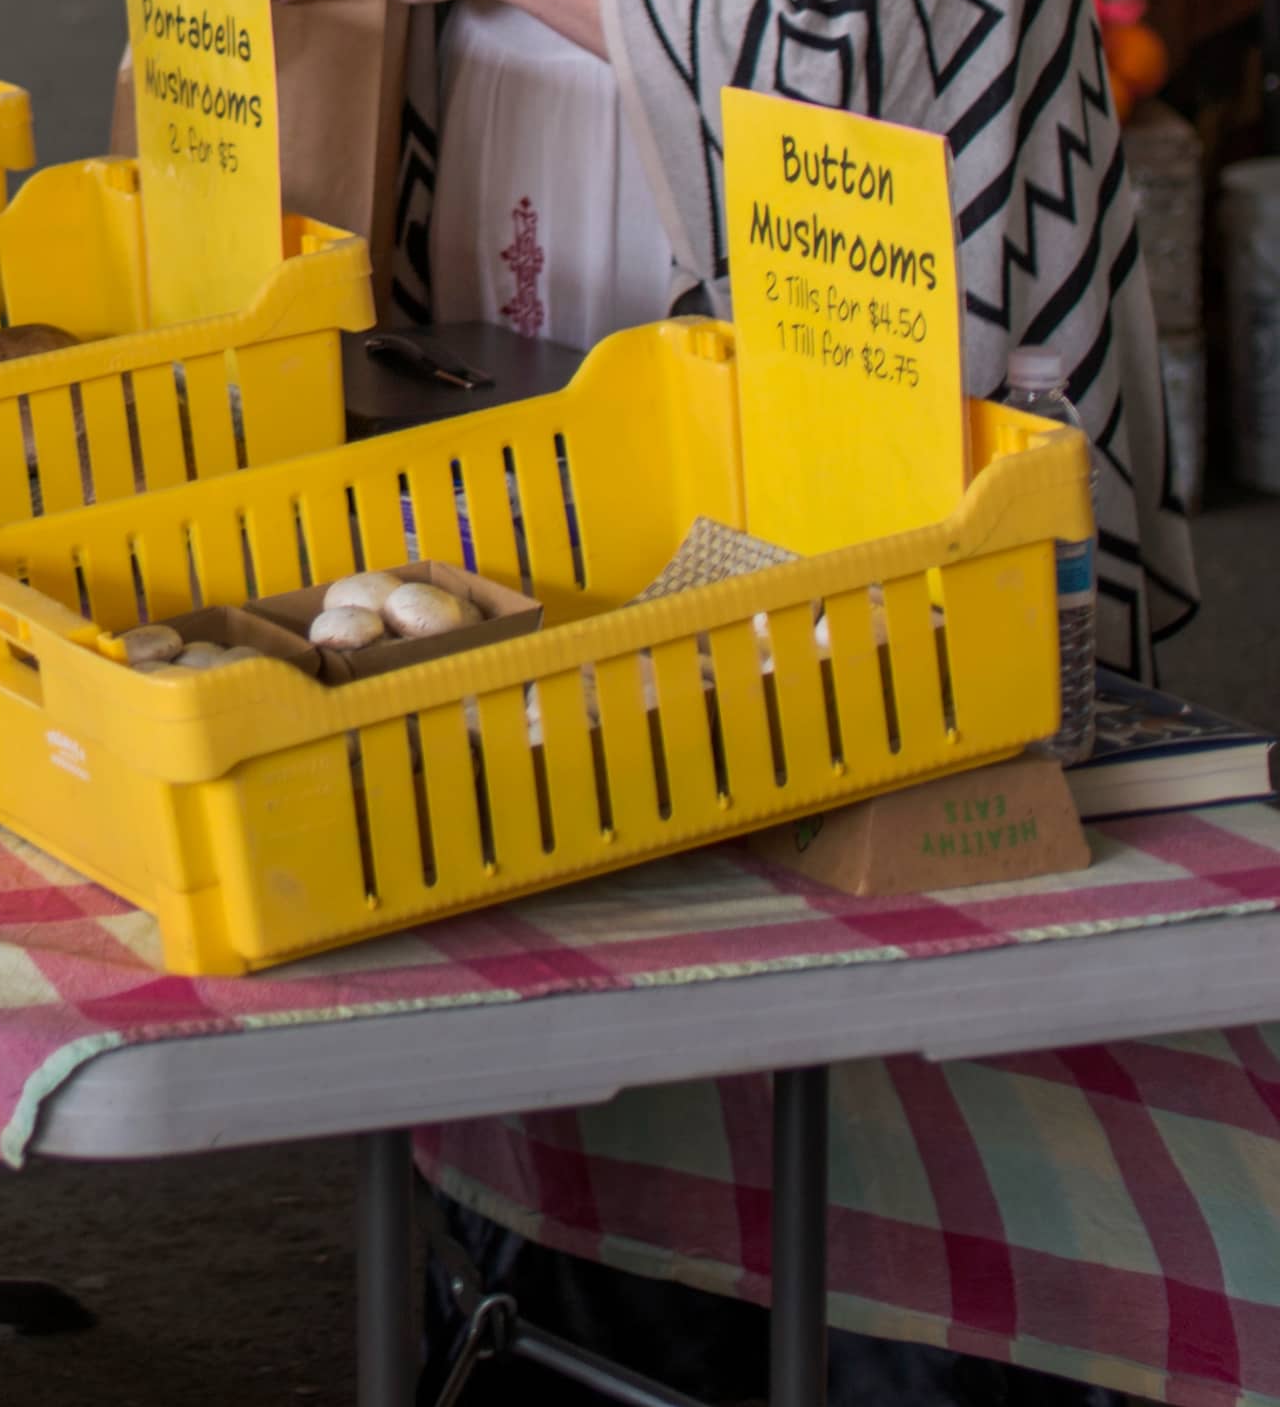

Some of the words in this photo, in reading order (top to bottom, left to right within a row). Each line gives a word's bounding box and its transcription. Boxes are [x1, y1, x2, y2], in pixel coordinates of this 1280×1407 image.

[145, 57, 262, 128] Mushrooms
[168, 123, 180, 154] 2
[188, 126, 212, 163] for
[218, 137, 238, 173] $5
[781, 135, 894, 206] Button
[750, 200, 936, 291] Mushrooms
[765, 271, 779, 302] 2
[785, 275, 820, 313] Tills
[827, 285, 861, 322] for
[869, 297, 927, 343] $4.50
[777, 320, 786, 350] 1
[791, 323, 815, 358] Till
[823, 330, 854, 367] for
[861, 343, 920, 388] $2.75
[921, 815, 1038, 857] HEALTHY
[943, 793, 1007, 825] EATS
